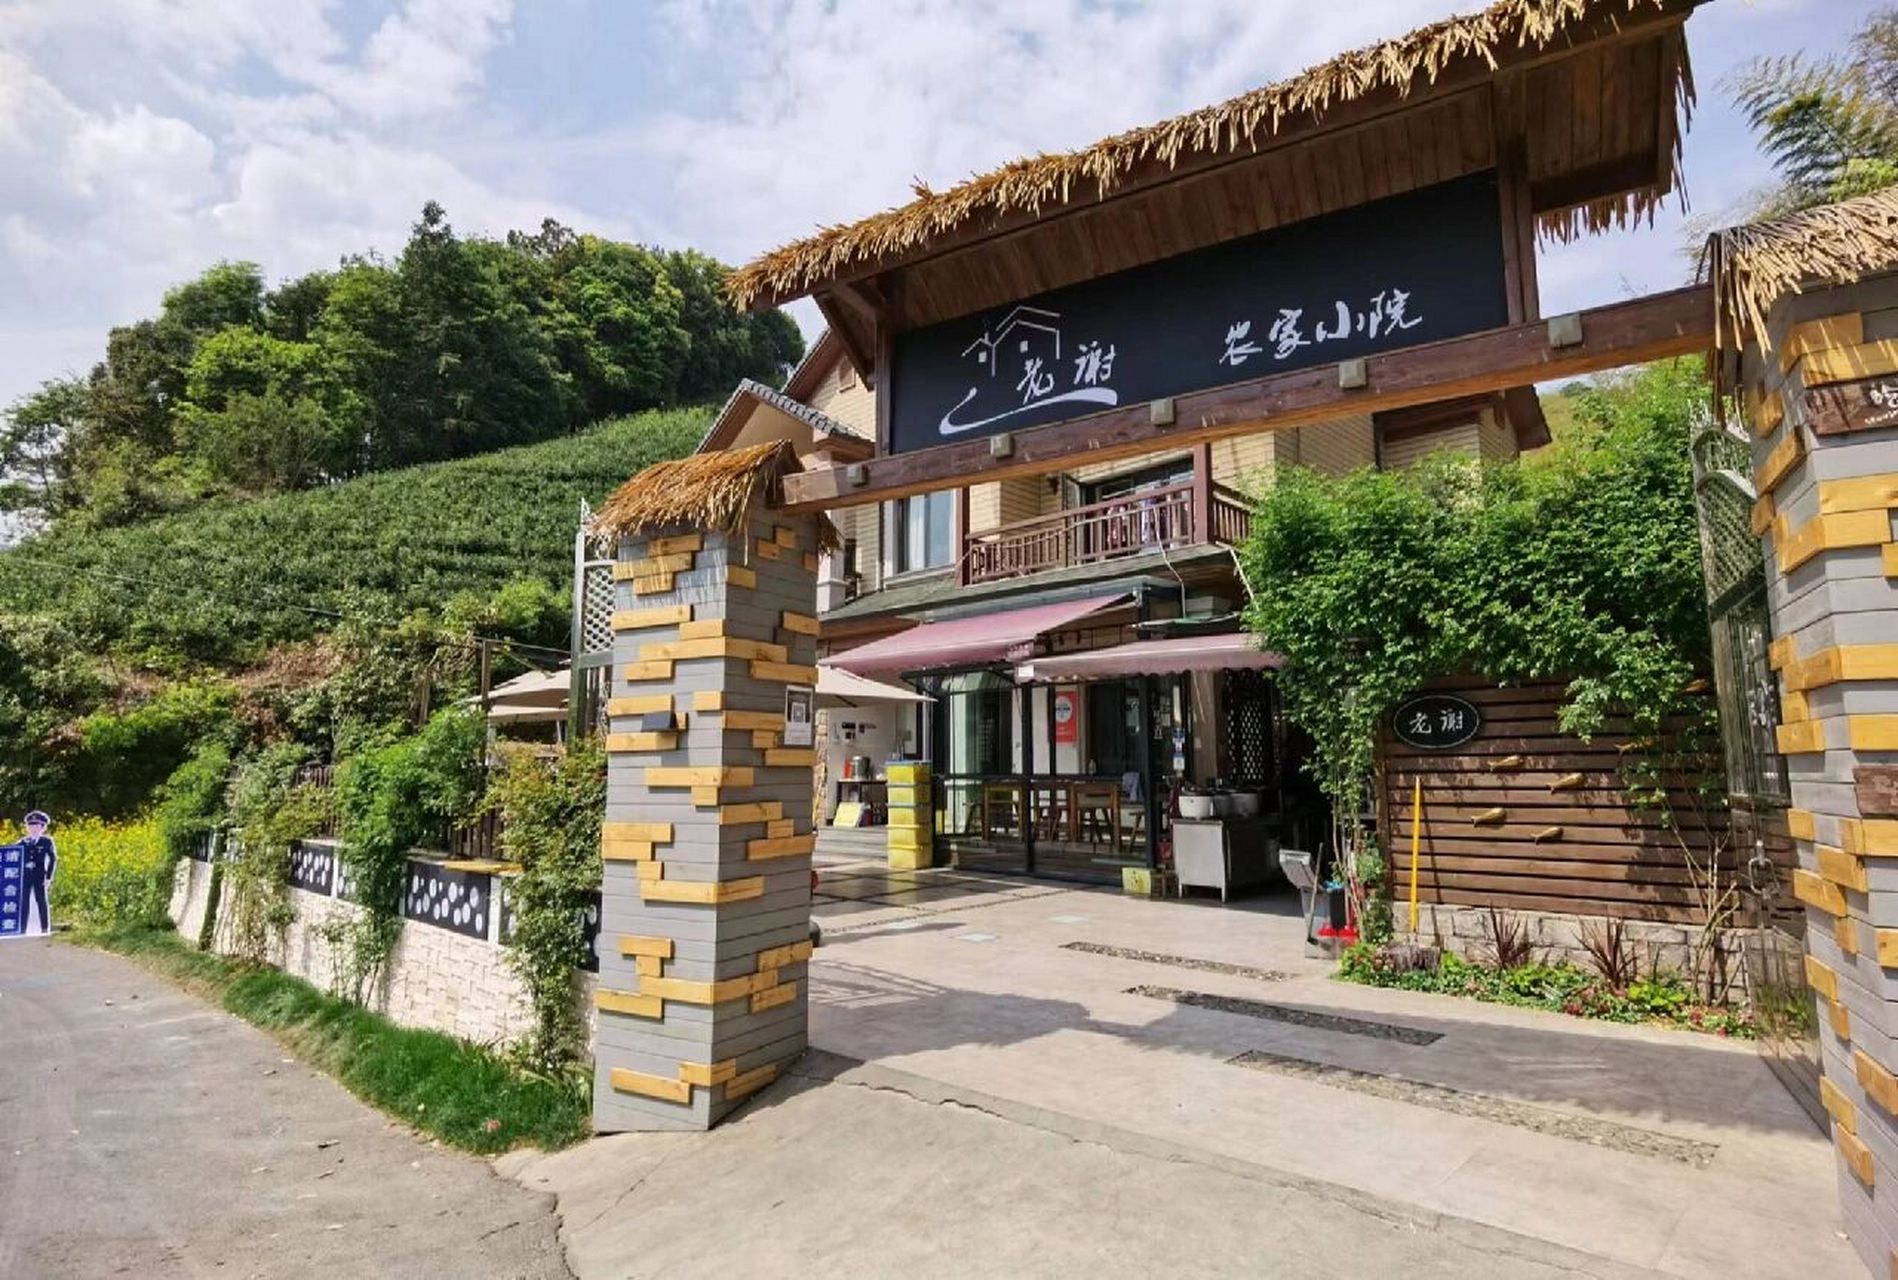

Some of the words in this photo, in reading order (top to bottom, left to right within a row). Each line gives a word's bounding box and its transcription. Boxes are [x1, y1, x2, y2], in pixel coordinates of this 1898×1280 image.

[1016, 341, 1117, 405] 老谢
[1219, 288, 1423, 366] 农家小院
[1409, 708, 1464, 734] 老谢
